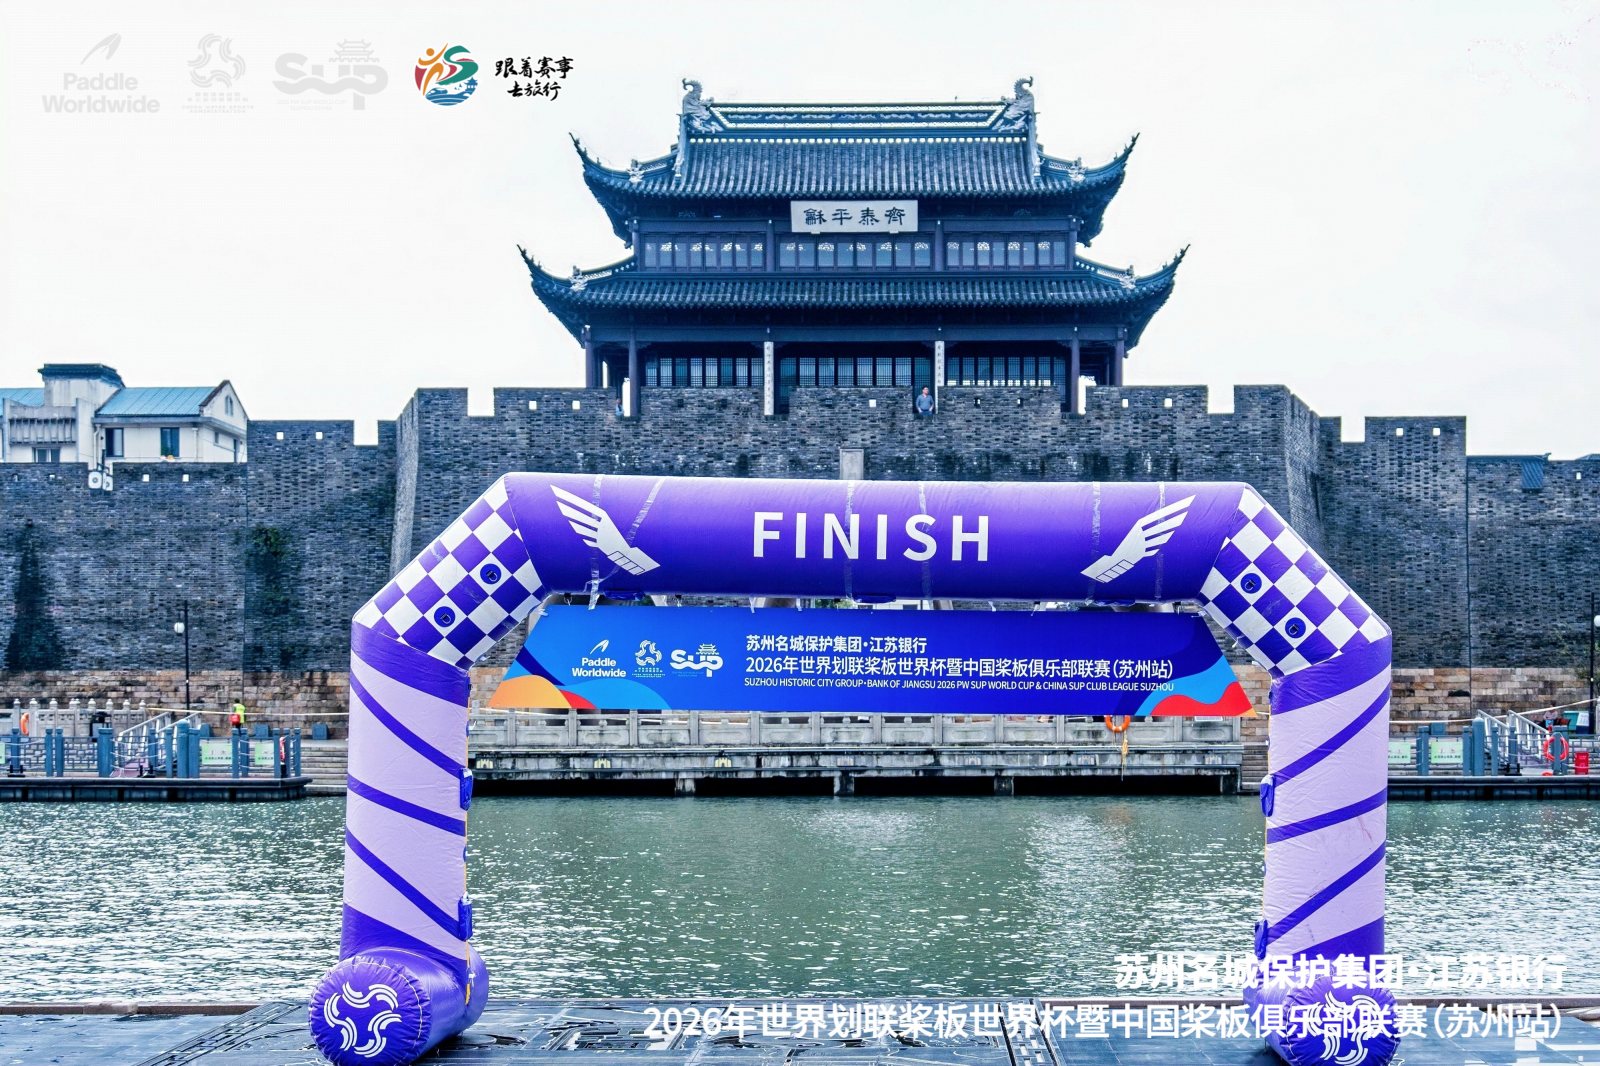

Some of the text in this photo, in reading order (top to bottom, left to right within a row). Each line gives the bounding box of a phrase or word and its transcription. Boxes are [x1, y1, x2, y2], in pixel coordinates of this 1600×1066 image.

[753, 511, 989, 562] FINISH
[746, 634, 928, 654] 苏州名城保护集团·江苏银行
[581, 657, 617, 667] Paddle
[571, 667, 627, 678] Worldwide
[744, 677, 778, 687] SUZHOU
[779, 677, 816, 688] HISTORIC
[816, 678, 835, 688] CITY
[889, 679, 901, 689] OF
[901, 679, 936, 689] JIANGSU
[936, 680, 956, 689] 2026
[956, 680, 970, 689] PW
[970, 680, 987, 690] SUP
[987, 680, 1017, 690] WORLD
[1017, 681, 1035, 690] CUP
[1035, 681, 1042, 690] &
[1042, 681, 1068, 690] CHINA
[1068, 681, 1086, 691] SUP
[1085, 681, 1108, 691] CLUB
[1108, 682, 1139, 691] LEAGUE
[1140, 682, 1175, 691] SUZHOU
